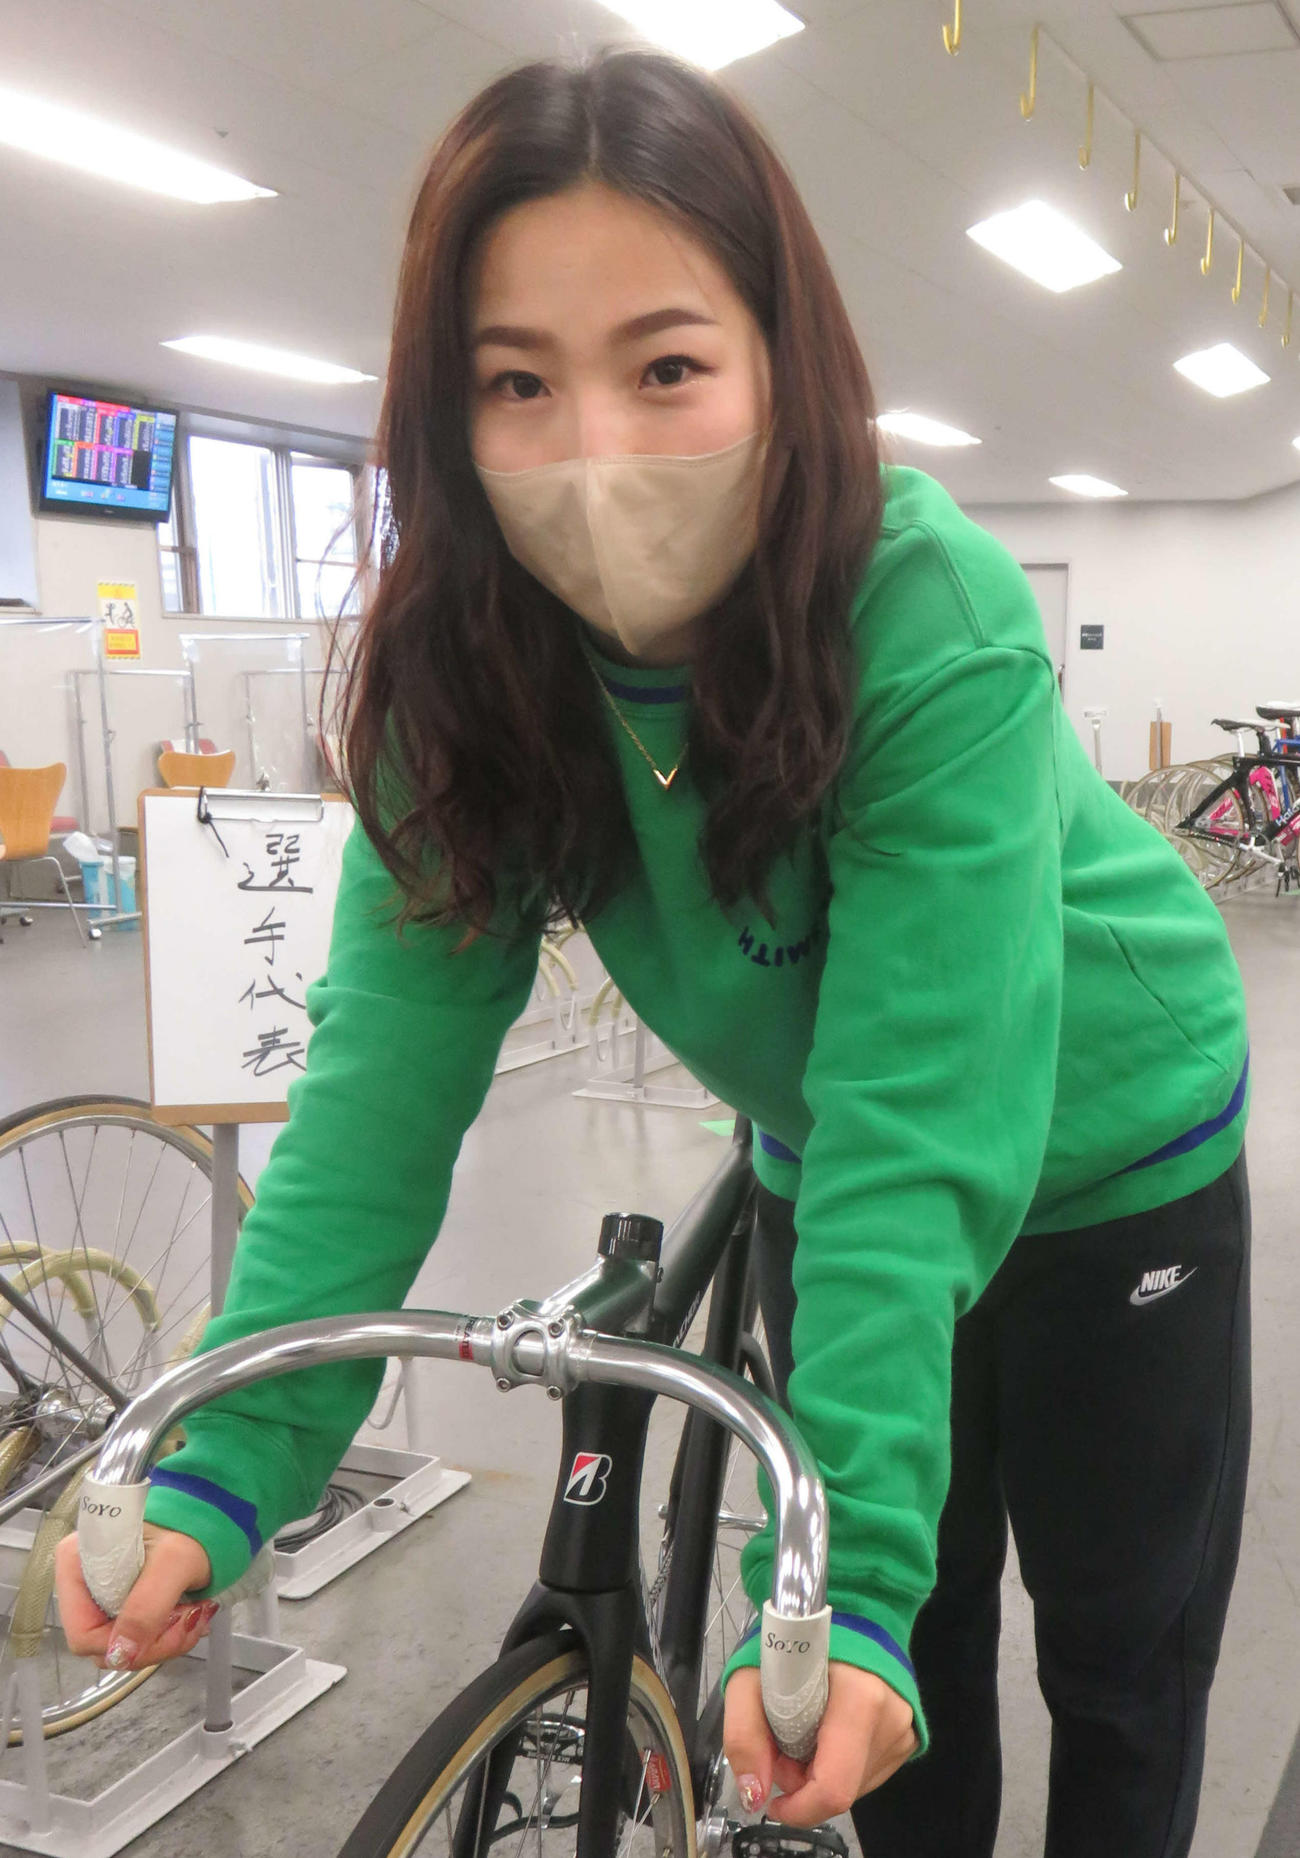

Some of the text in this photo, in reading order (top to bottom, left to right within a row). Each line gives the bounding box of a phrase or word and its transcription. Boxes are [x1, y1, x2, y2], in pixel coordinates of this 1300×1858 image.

[237, 833, 314, 1077] 選手代表
[737, 925, 814, 968] MITH
[1140, 1264, 1182, 1293] NIKE
